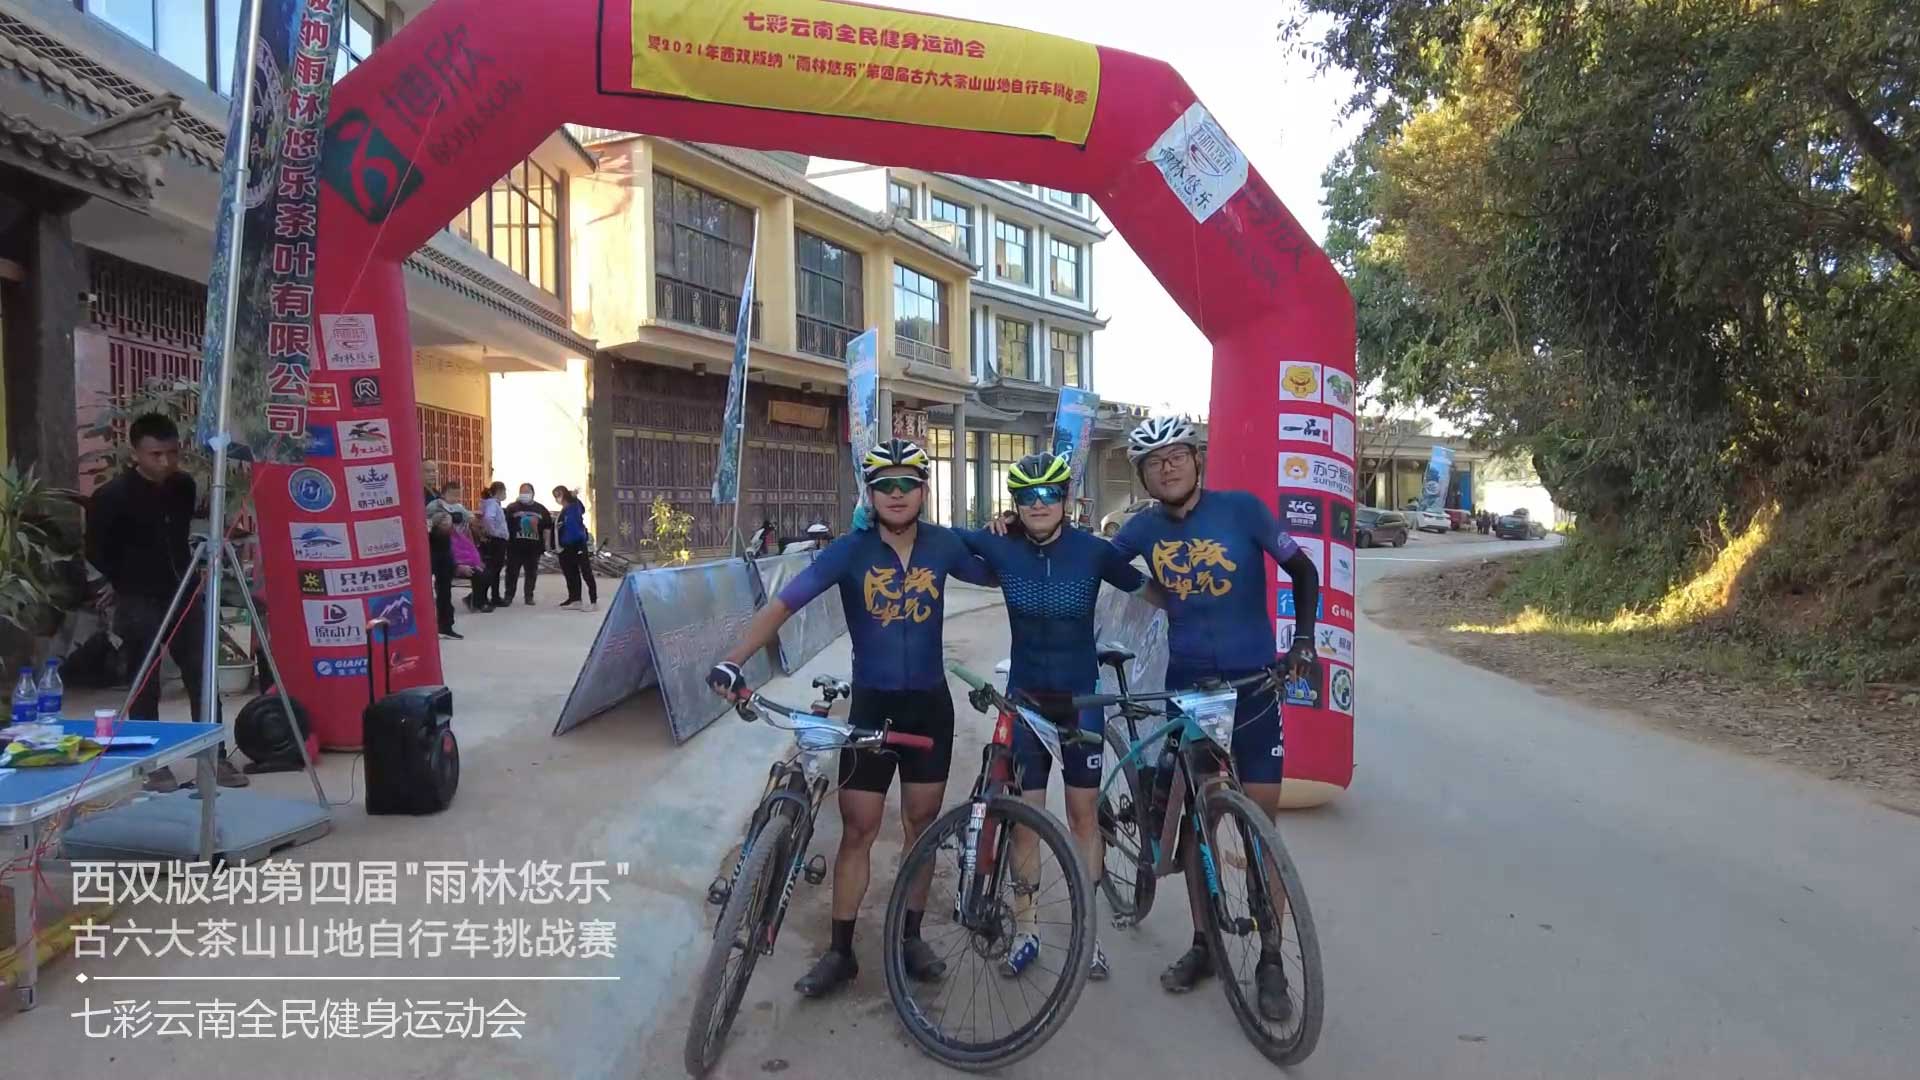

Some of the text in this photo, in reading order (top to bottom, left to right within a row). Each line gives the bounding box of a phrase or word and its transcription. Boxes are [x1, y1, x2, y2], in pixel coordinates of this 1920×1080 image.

[743, 11, 985, 59] 七彩云南全民健身运动会
[1159, 147, 1212, 209] 雨林悠乐
